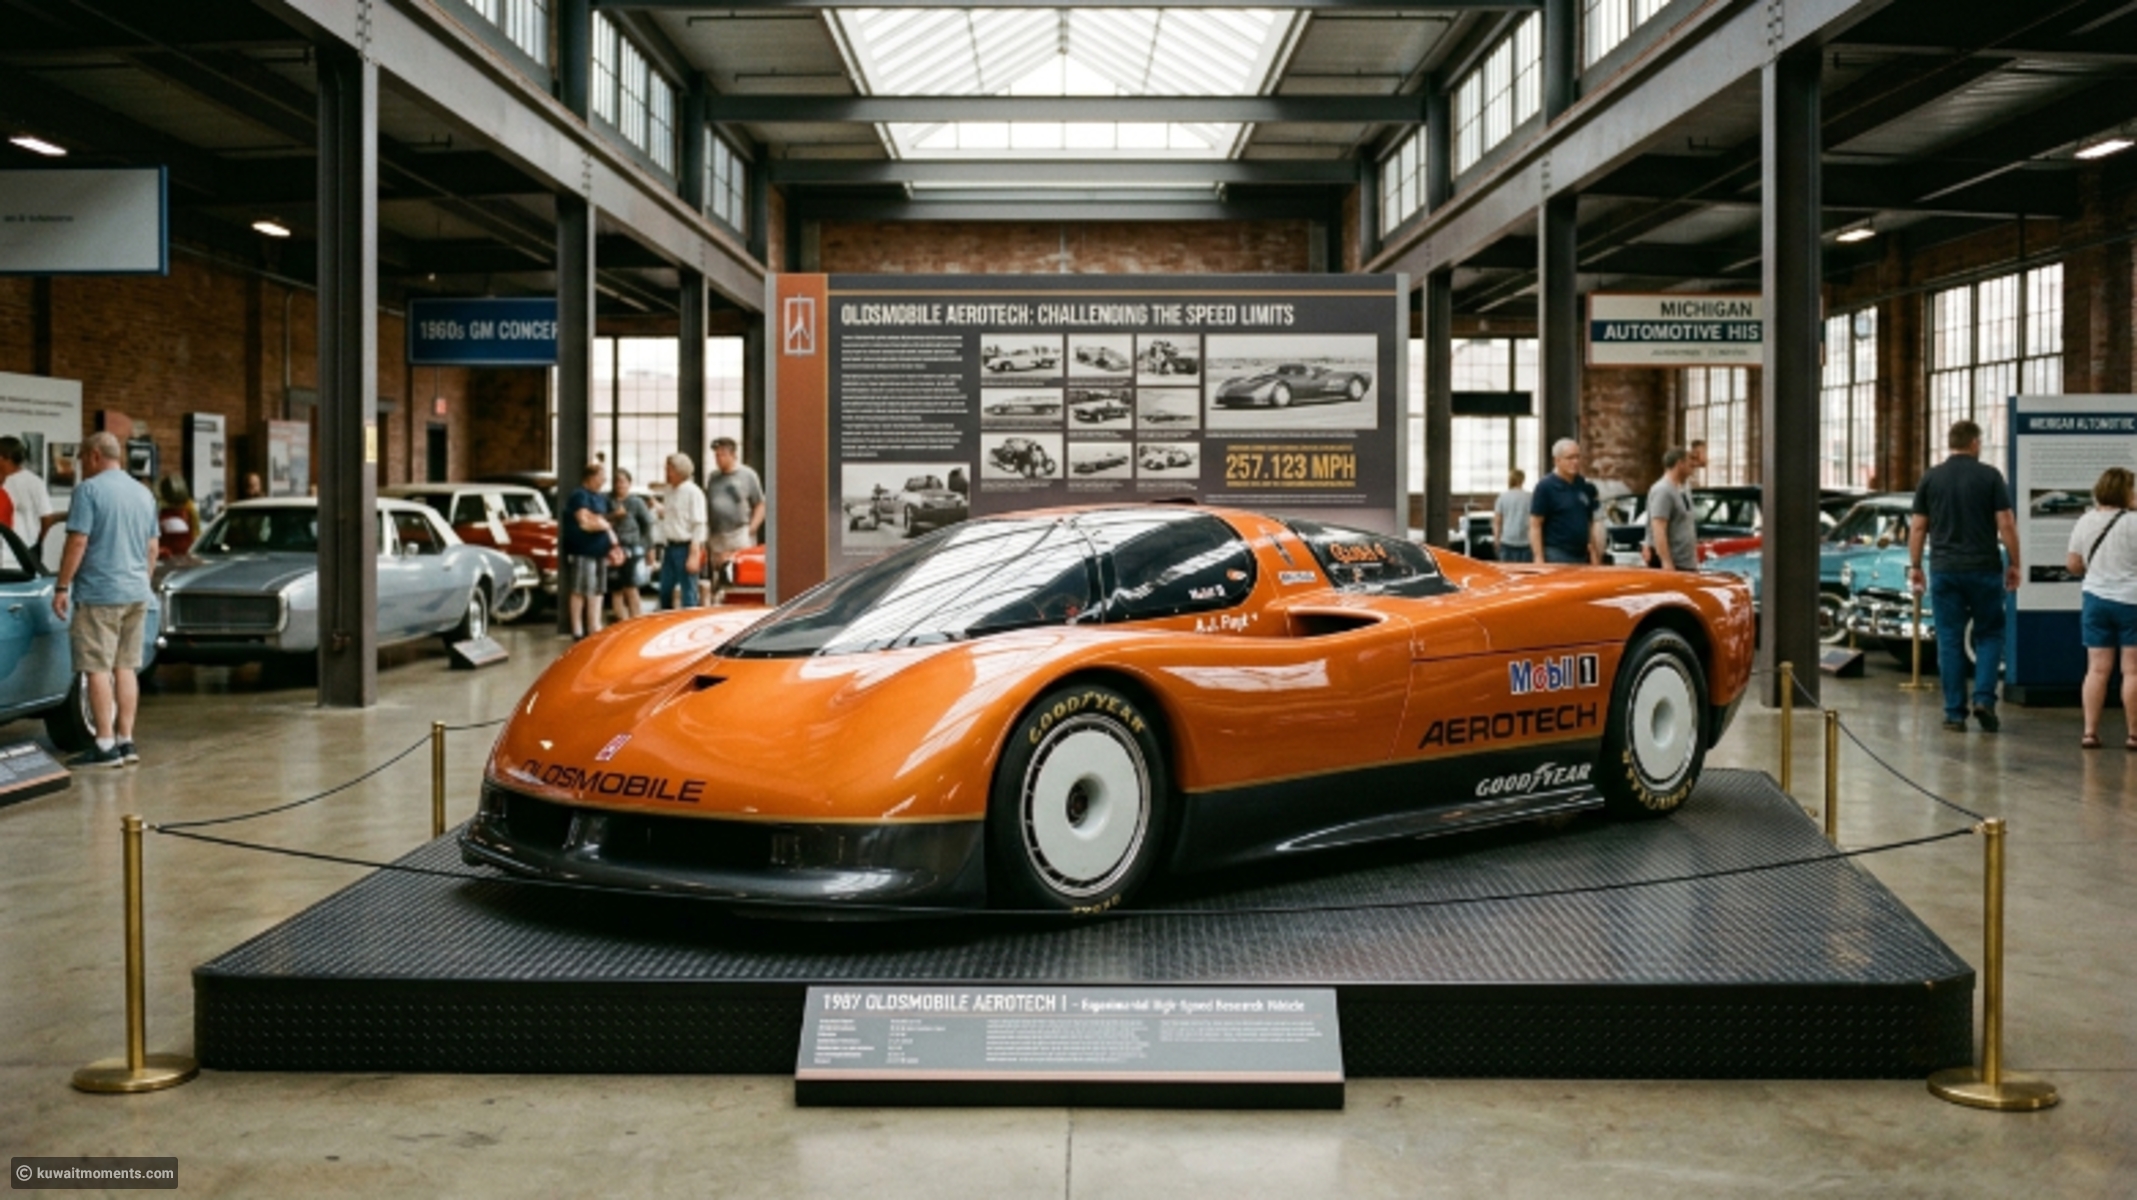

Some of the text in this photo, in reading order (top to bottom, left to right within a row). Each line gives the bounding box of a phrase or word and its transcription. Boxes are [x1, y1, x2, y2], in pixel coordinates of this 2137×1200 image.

[841, 303, 942, 325] OLDSMOBILE
[946, 303, 1035, 325] AEROTECH:
[1152, 303, 1183, 325] THE
[1185, 303, 1236, 325] SPEED
[1241, 303, 1295, 325] LIMITS
[1660, 301, 1753, 317] MICHIGAN
[420, 319, 465, 340] 1960s
[469, 319, 494, 340] GM
[1604, 324, 1722, 340] AUTOMOTIVE
[1225, 454, 1356, 480] 257.123 MPH
[1508, 655, 1596, 695] Mobil 1
[1028, 691, 1146, 744] GOODYEAR
[1418, 702, 1598, 750] AEROTECH
[1474, 762, 1593, 797] GOODYEAR
[866, 993, 969, 1012] OLDSMOBILE
[972, 994, 1056, 1012] AEROTECH
